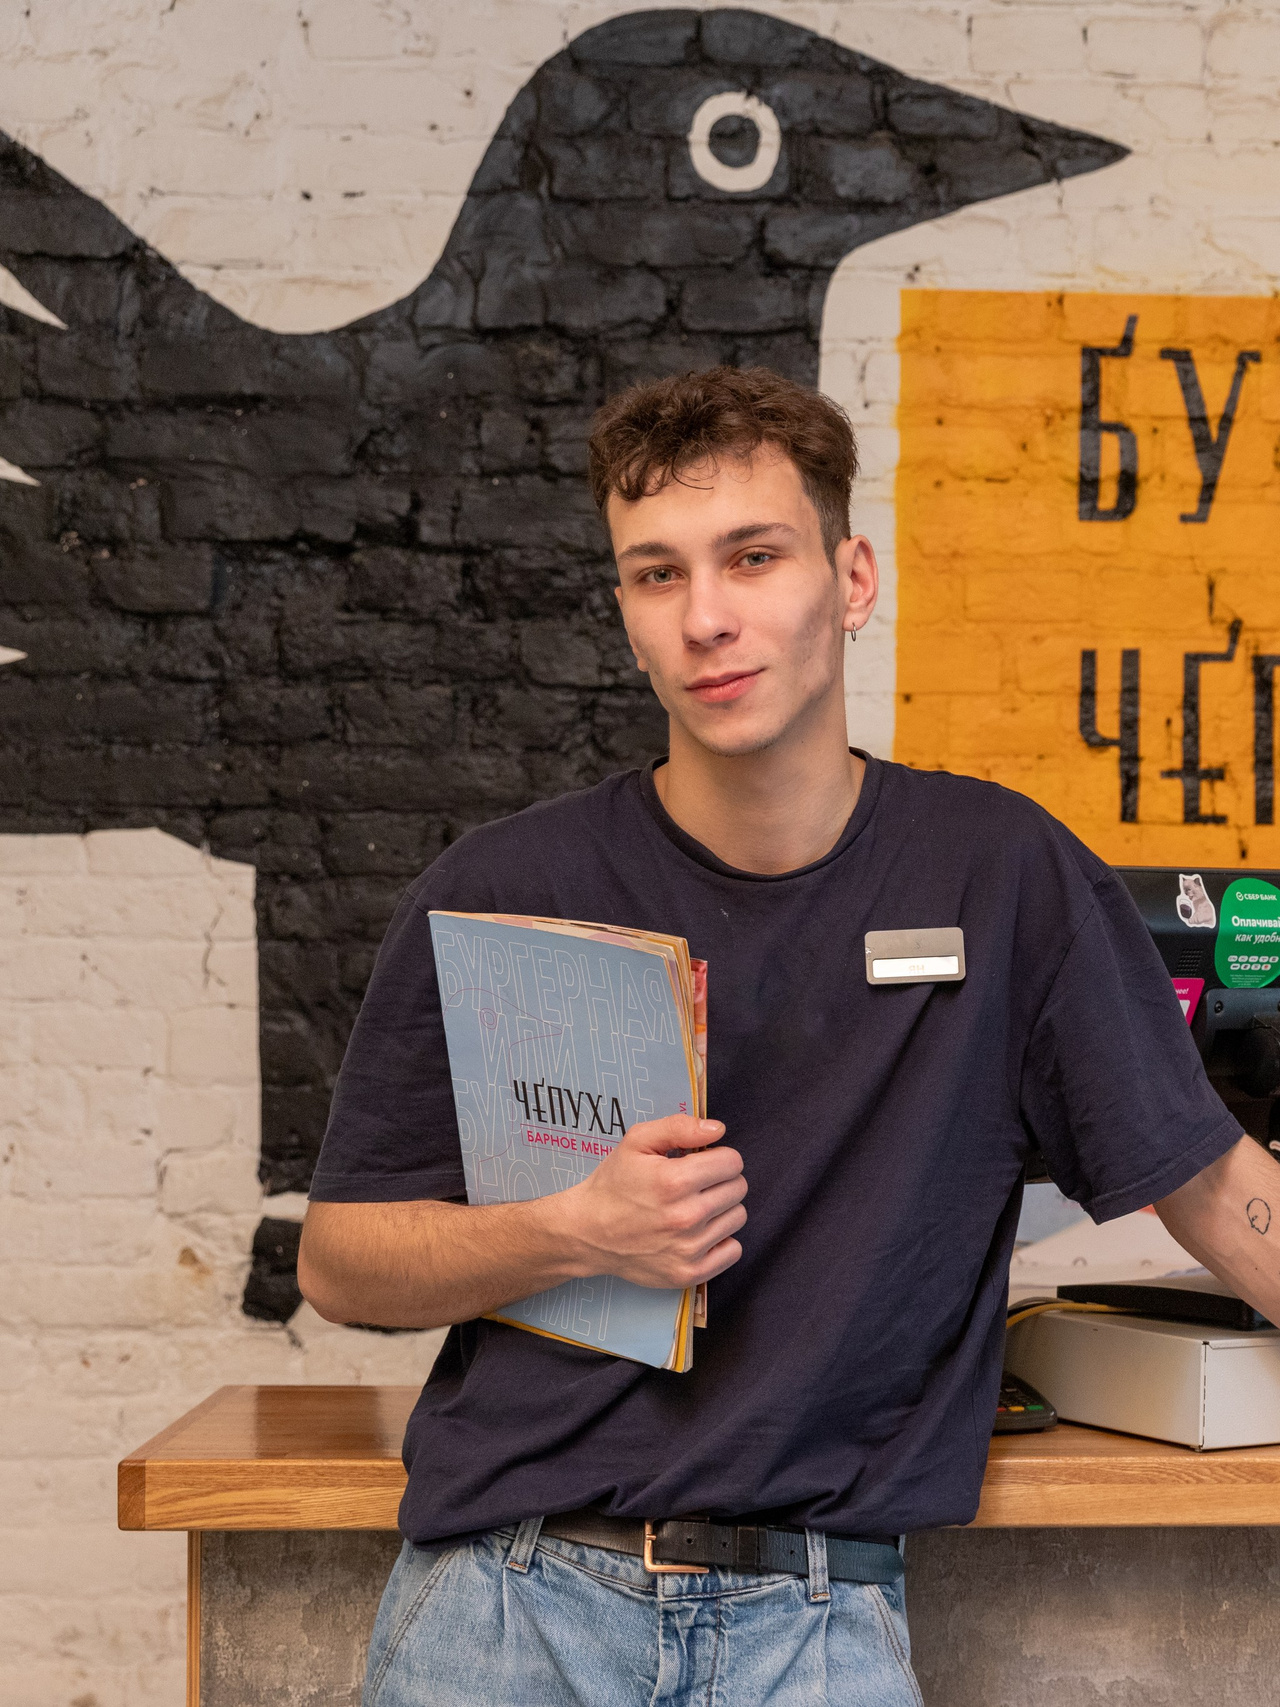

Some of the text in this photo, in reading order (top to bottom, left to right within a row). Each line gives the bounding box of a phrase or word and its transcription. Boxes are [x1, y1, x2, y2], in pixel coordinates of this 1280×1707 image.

[1235, 933, 1253, 942] как
[434, 929, 676, 1046] БУРГЕРНАЯ
[479, 1011, 654, 1115] ИЛИ НЕ
[512, 1077, 626, 1137] ЧЕПУХА
[526, 1129, 613, 1156] БАРНОЕ МЕН
